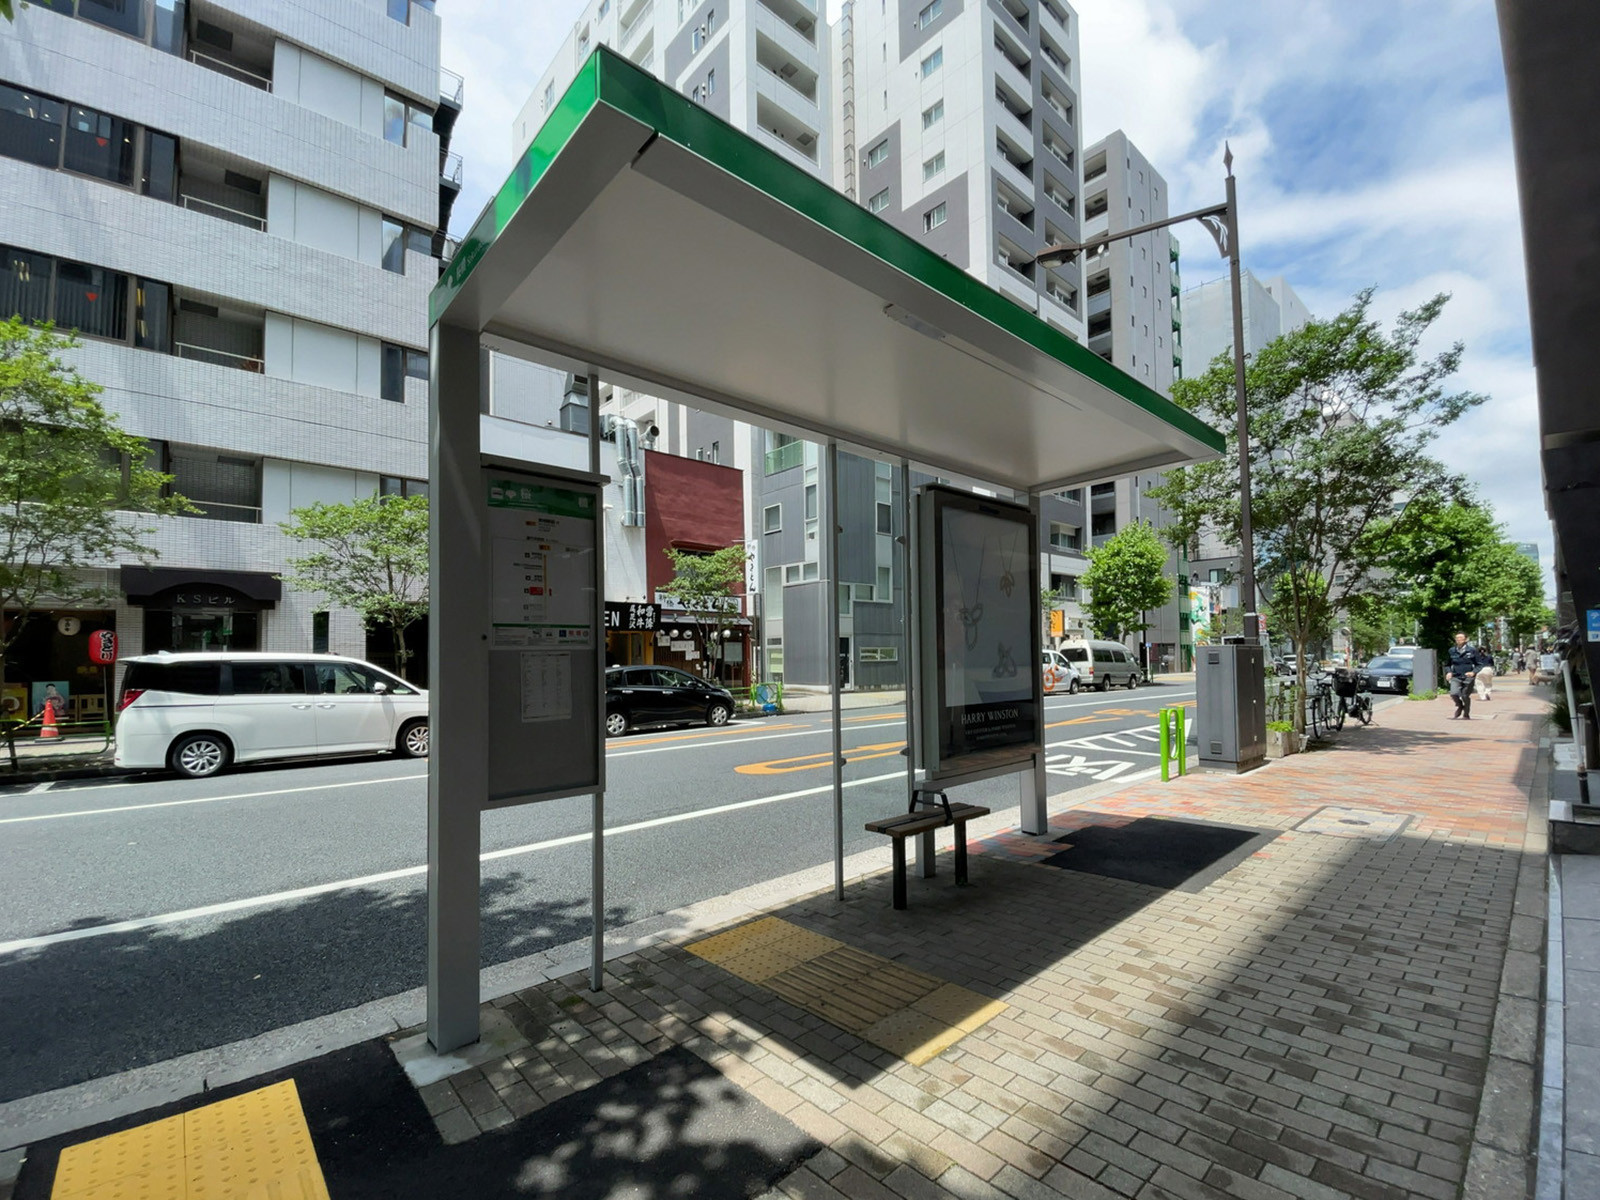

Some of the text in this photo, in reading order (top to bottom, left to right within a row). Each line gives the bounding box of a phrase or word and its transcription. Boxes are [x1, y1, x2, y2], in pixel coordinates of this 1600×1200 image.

[636, 604, 645, 629] 和牛
[961, 708, 1018, 725] HARRY WINSTON
